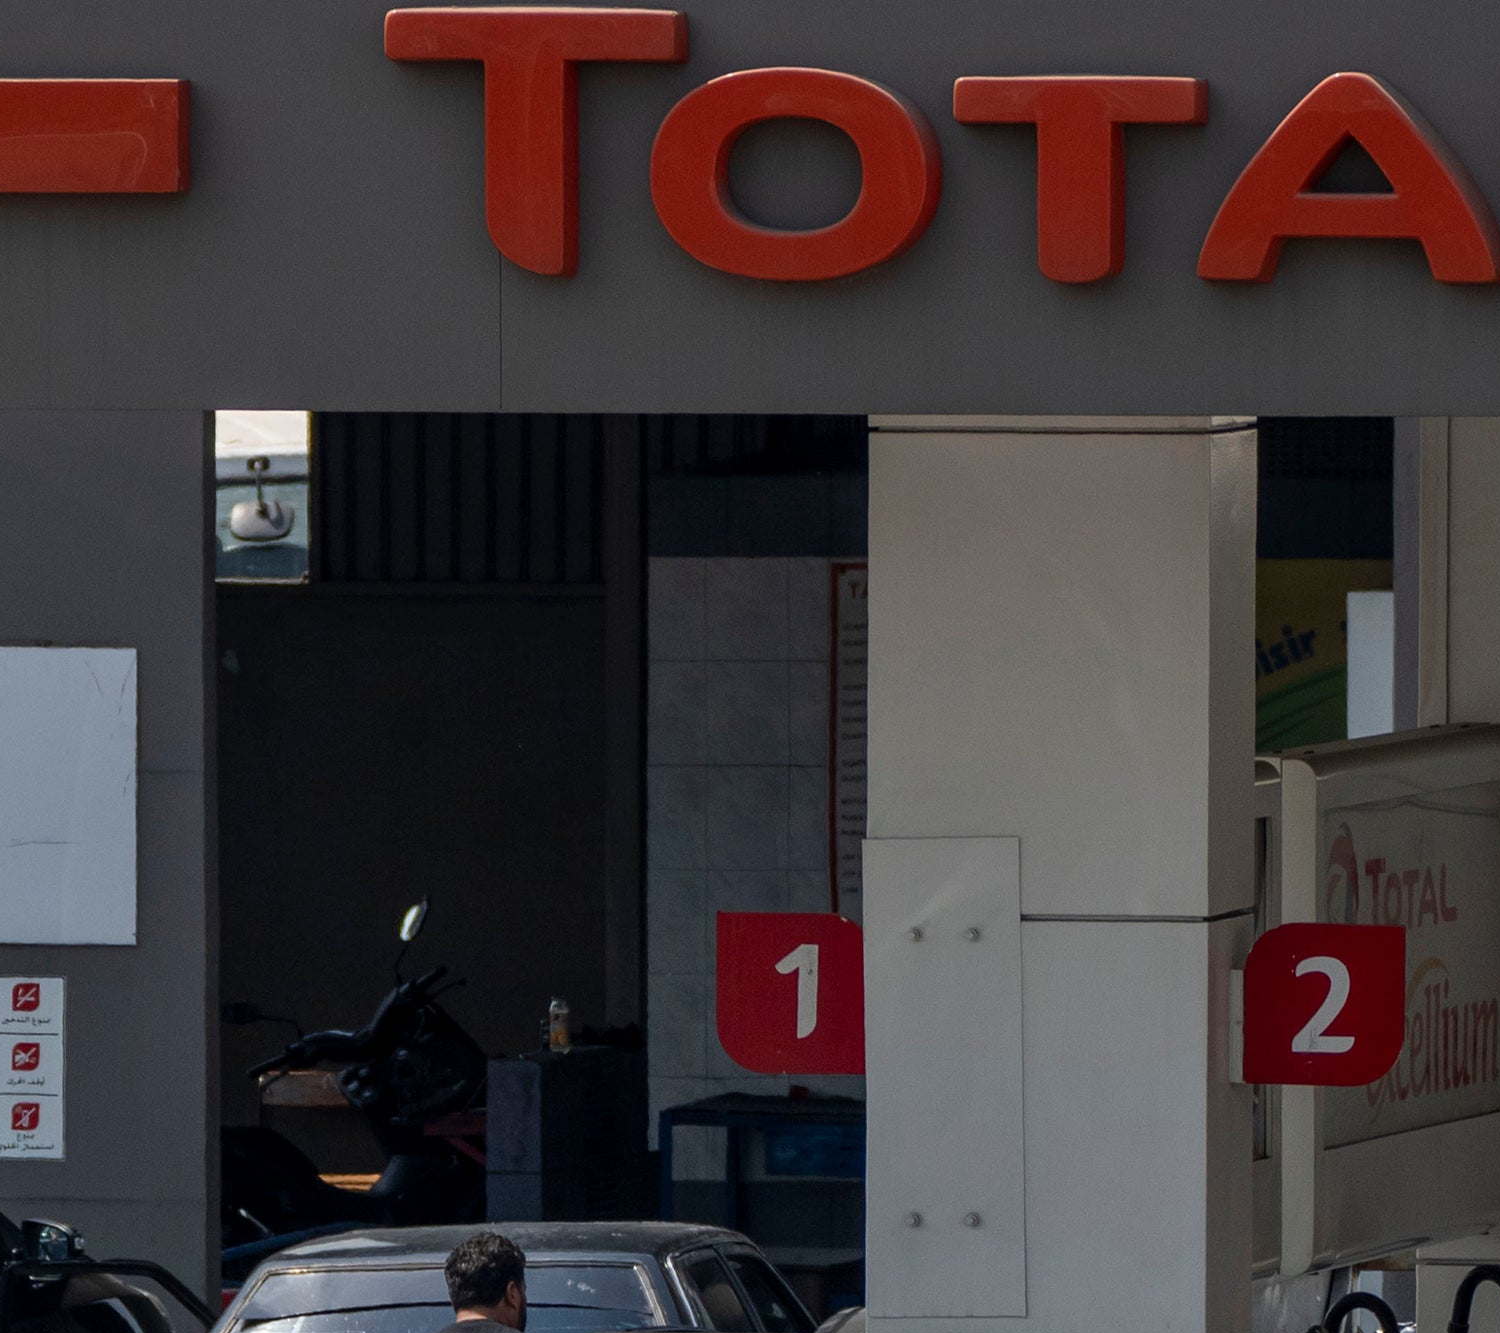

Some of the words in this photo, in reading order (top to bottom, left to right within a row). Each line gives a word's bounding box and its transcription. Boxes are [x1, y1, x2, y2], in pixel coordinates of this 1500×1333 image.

[1365, 858, 1457, 929] TOTAL
[774, 943, 819, 1039] 1
[1291, 955, 1355, 1053] 2
